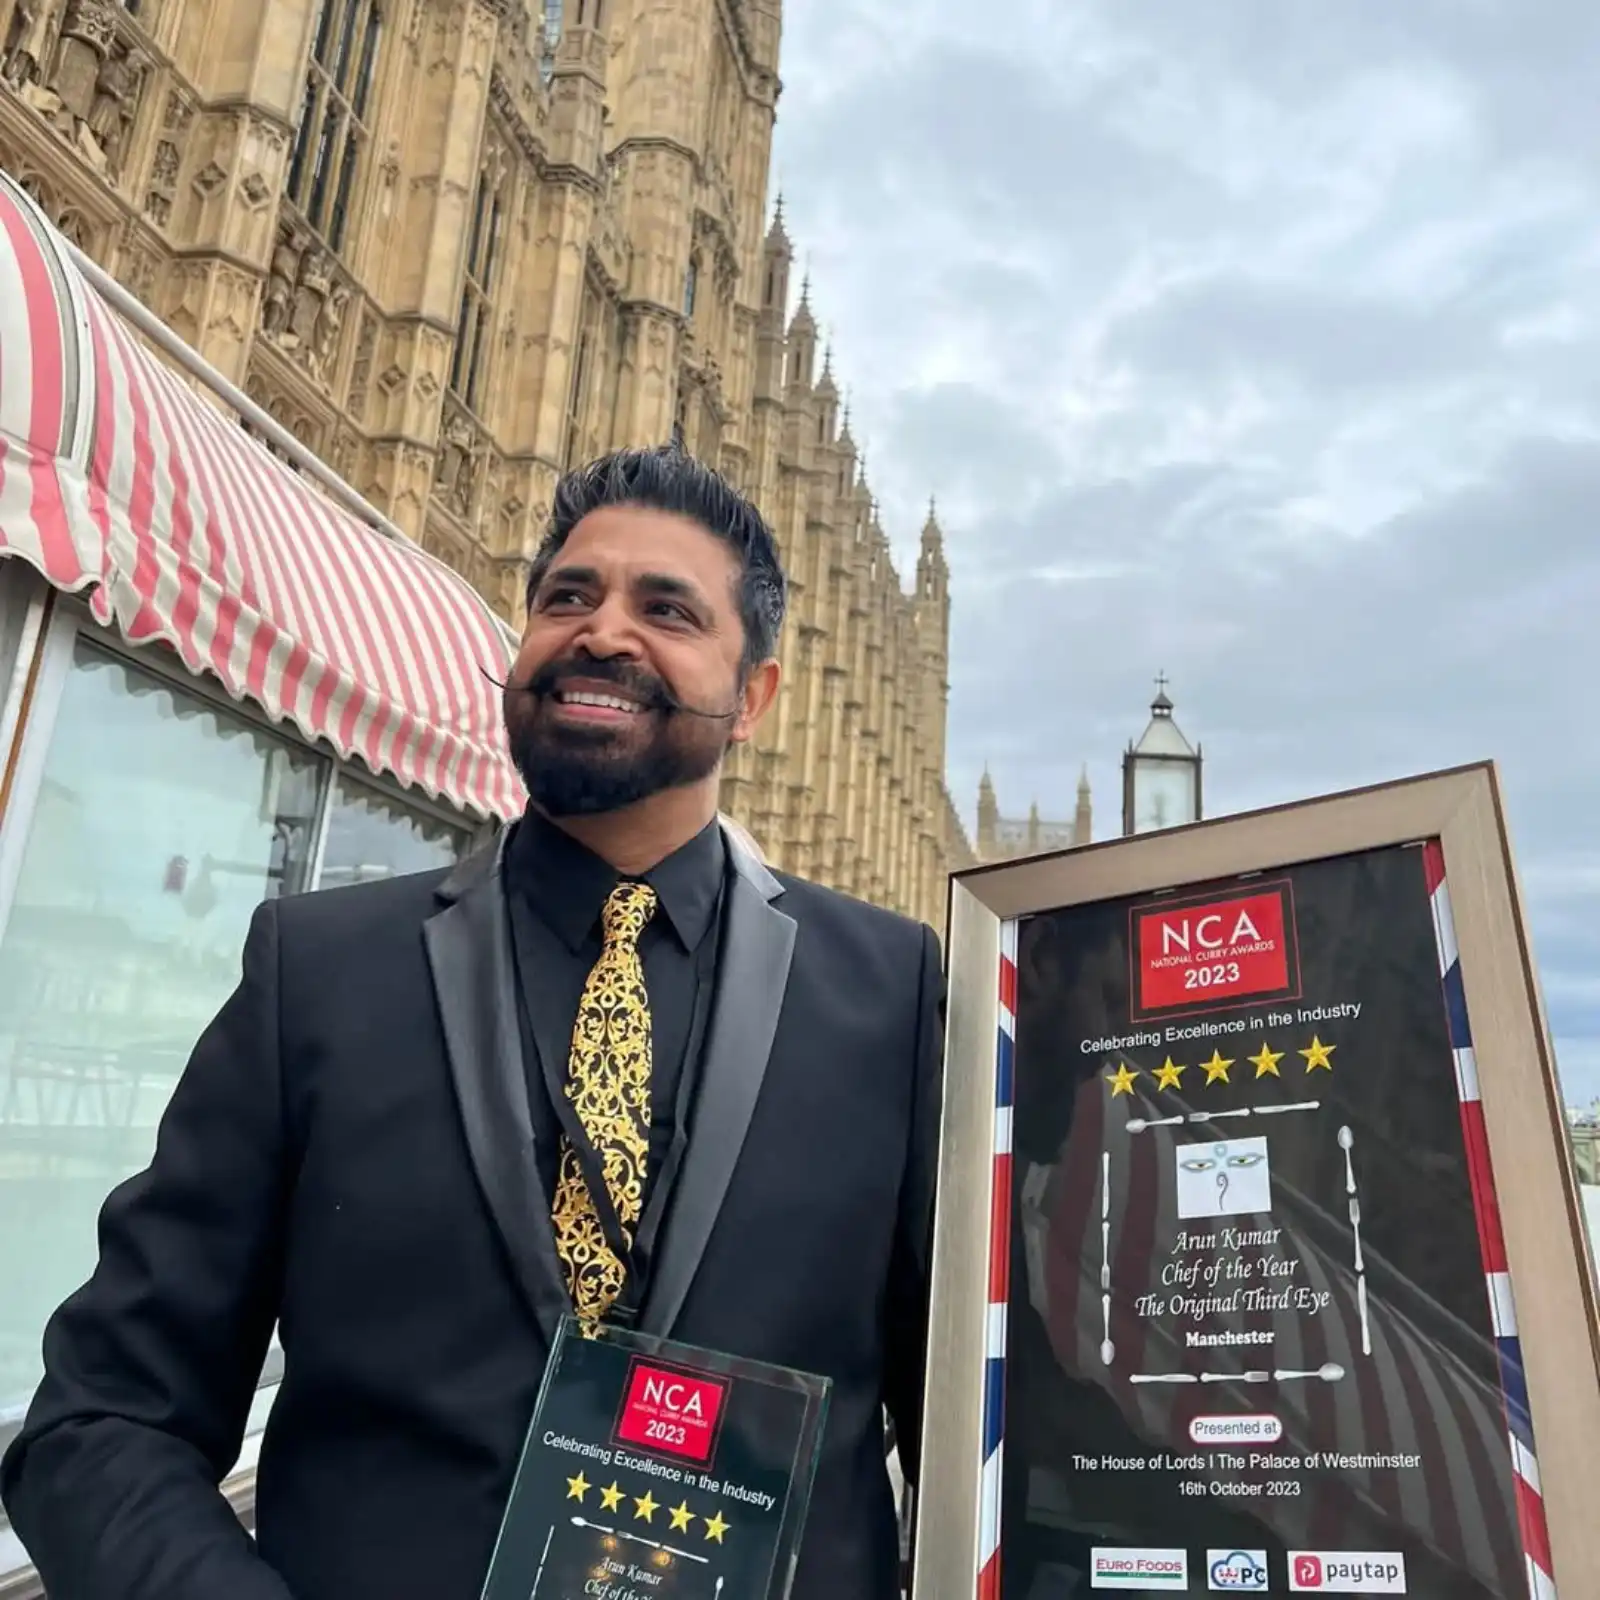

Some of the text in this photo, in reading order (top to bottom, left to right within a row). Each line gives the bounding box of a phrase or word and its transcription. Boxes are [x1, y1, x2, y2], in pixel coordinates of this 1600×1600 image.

[1162, 909, 1261, 955] NCA
[1151, 939, 1275, 969] NATIONAL CURRY AWARDS
[1184, 962, 1240, 989] 2023
[1080, 1002, 1362, 1053] Celebrating Excellence in the Industry
[1171, 1227, 1282, 1254] Arun Kumar
[1162, 1255, 1299, 1289] Chef of the Year
[1135, 1285, 1330, 1321] The Original Third Eye
[1186, 1330, 1275, 1348] Manchester
[643, 1375, 703, 1418] NCA
[644, 1419, 686, 1444] 2023
[1194, 1420, 1277, 1436] Presented at
[543, 1430, 776, 1512] Celebrating Excellence in the Industry
[1072, 1455, 1098, 1470] The
[1101, 1455, 1145, 1470] House
[1149, 1454, 1163, 1470] of
[1165, 1454, 1205, 1470] Lords
[1218, 1453, 1246, 1470] The
[1250, 1453, 1300, 1470] Palace
[1304, 1453, 1320, 1469] of
[1323, 1452, 1421, 1469] Westminster
[1178, 1481, 1301, 1496] 16th October 2023
[1326, 1561, 1399, 1583] paytap
